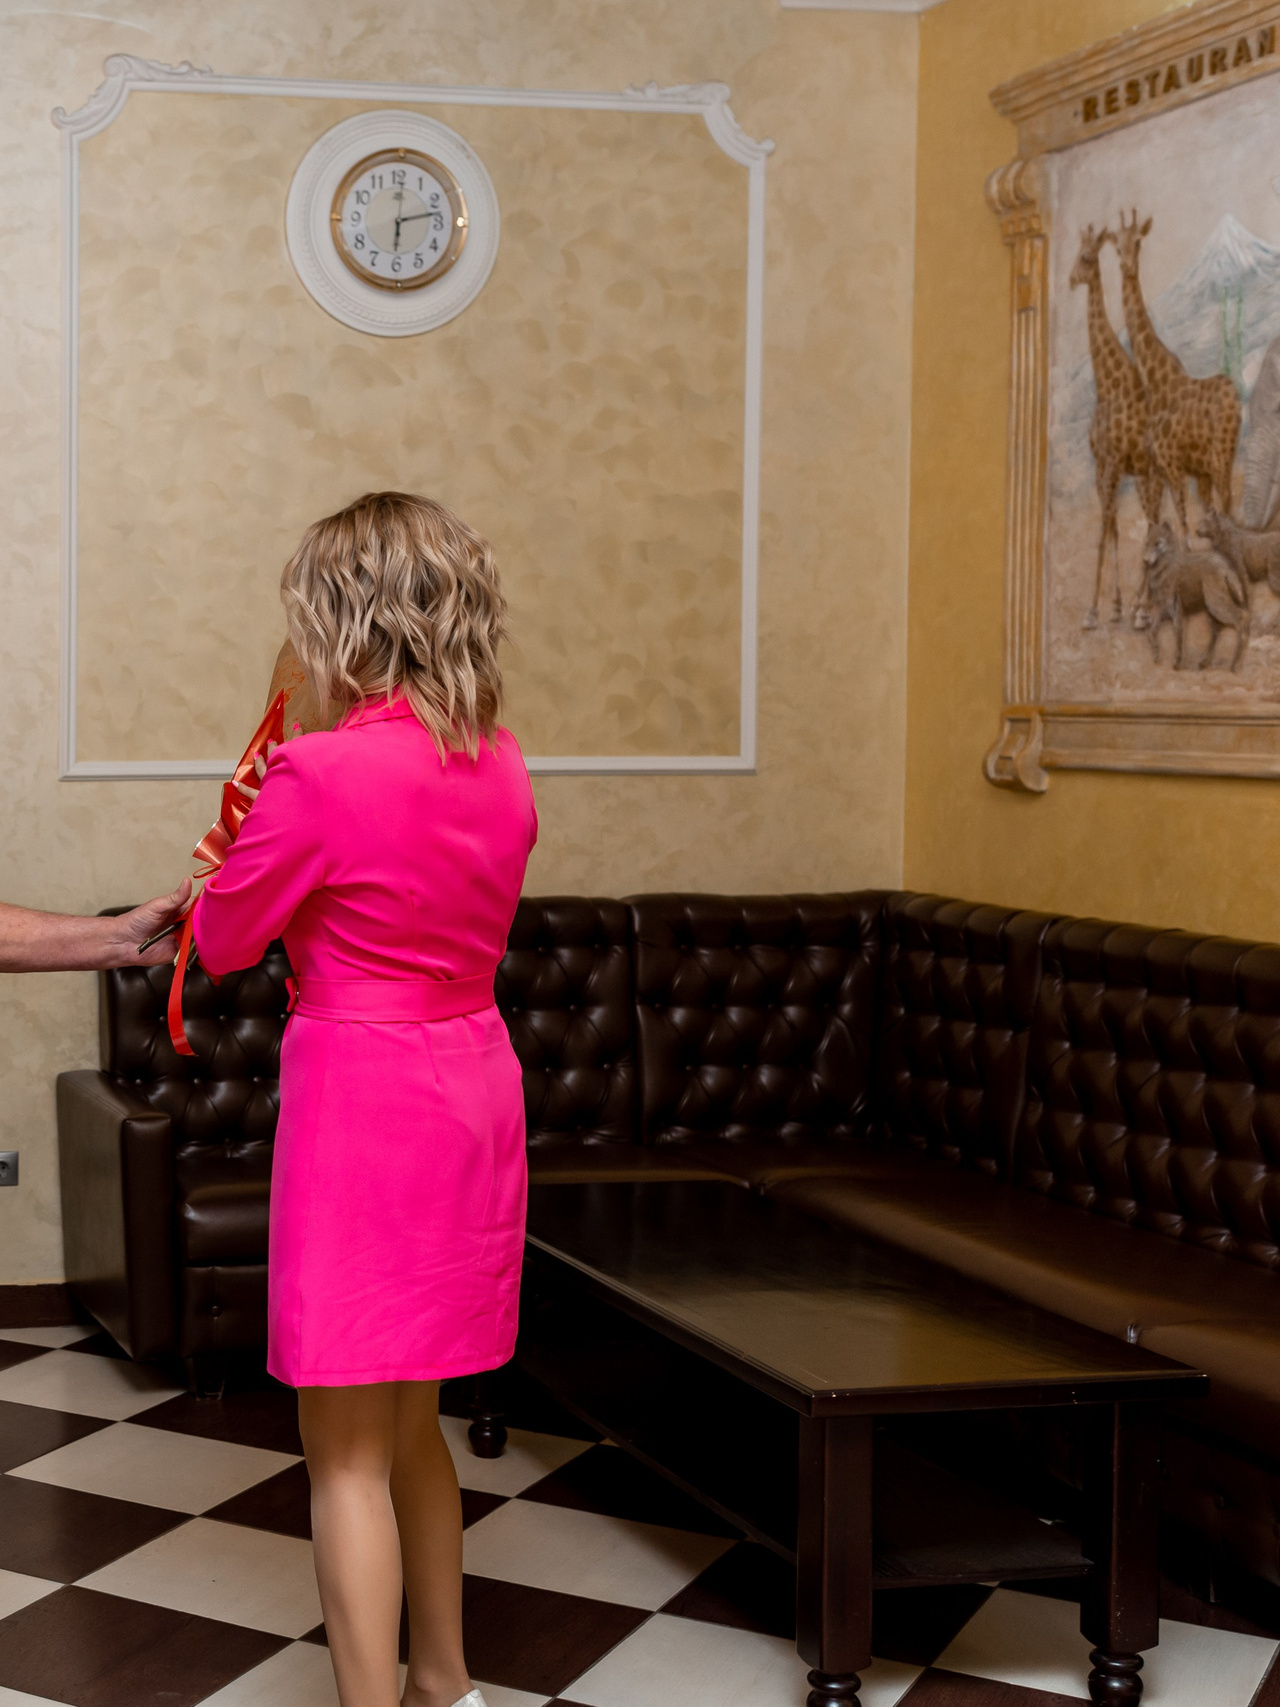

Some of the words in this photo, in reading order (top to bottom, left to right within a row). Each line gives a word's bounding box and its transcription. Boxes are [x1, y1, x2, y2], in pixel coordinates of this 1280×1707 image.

[1082, 26, 1276, 123] RESTAURAN
[371, 174, 384, 189] 11
[355, 190, 370, 205] 10
[430, 192, 440, 208] 2
[351, 211, 361, 227] 9
[354, 233, 365, 250] 8
[429, 237, 439, 252] 4
[369, 250, 379, 266] 7
[391, 256, 402, 273] 6
[413, 253, 424, 269] 5
